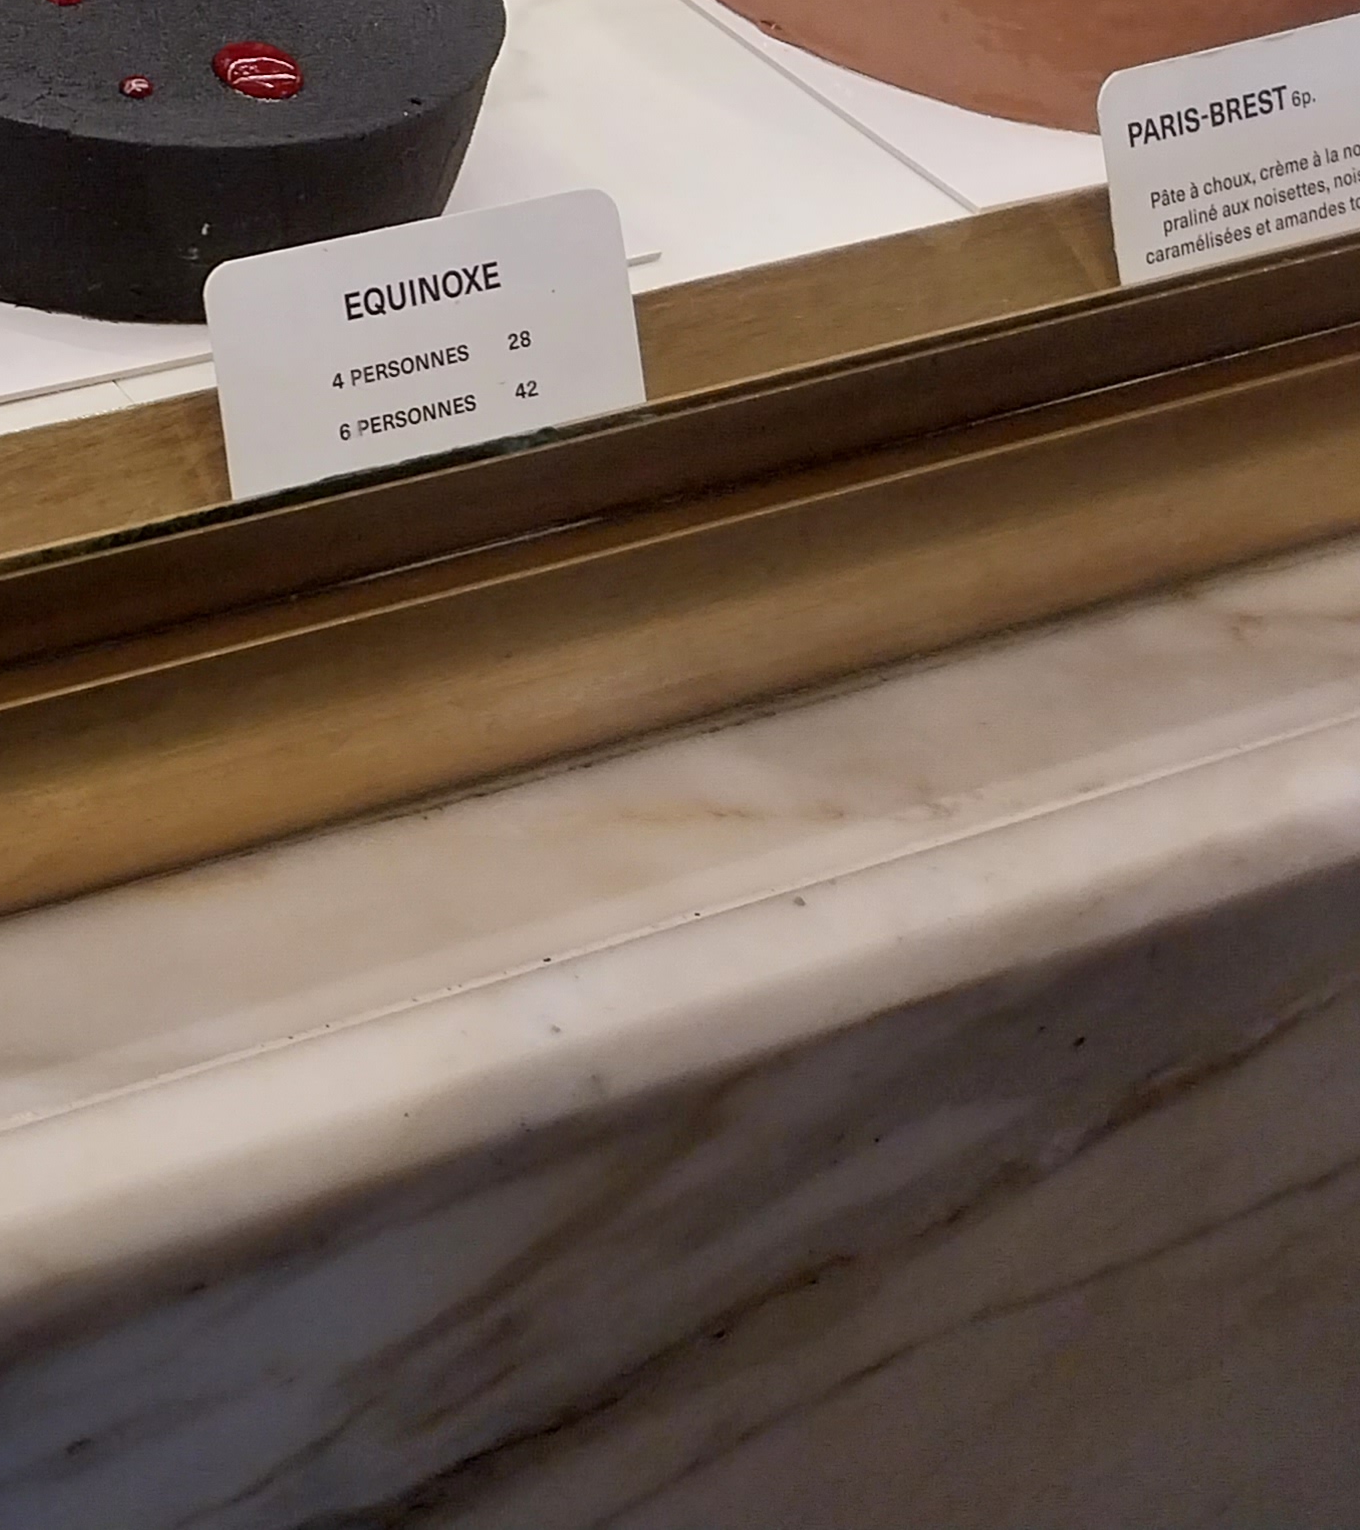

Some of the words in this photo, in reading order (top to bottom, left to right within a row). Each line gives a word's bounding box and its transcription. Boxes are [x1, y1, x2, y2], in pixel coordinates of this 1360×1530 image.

[1128, 85, 1287, 148] PARIS-BREST
[1292, 90, 1316, 108] 6p.
[1151, 189, 1185, 209] Pâte
[1191, 182, 1199, 198] à
[1204, 172, 1256, 195] choux,
[1260, 158, 1309, 181] crème
[1313, 151, 1321, 167] à
[1325, 148, 1339, 163] la
[1163, 208, 1217, 237] praliné
[1223, 197, 1249, 217] aux
[1254, 179, 1330, 210] noisettes,
[1334, 168, 1360, 189] noi
[1146, 224, 1252, 264] caramélisées
[1256, 217, 1272, 235] et
[1276, 195, 1346, 230] amandes
[344, 262, 501, 320] EQUINOXE
[332, 373, 344, 389] 4
[350, 345, 470, 386] PERSONNES
[508, 331, 531, 350] 28
[339, 424, 351, 441] 6
[357, 395, 476, 437] PERSONNES
[515, 380, 539, 400] 42
